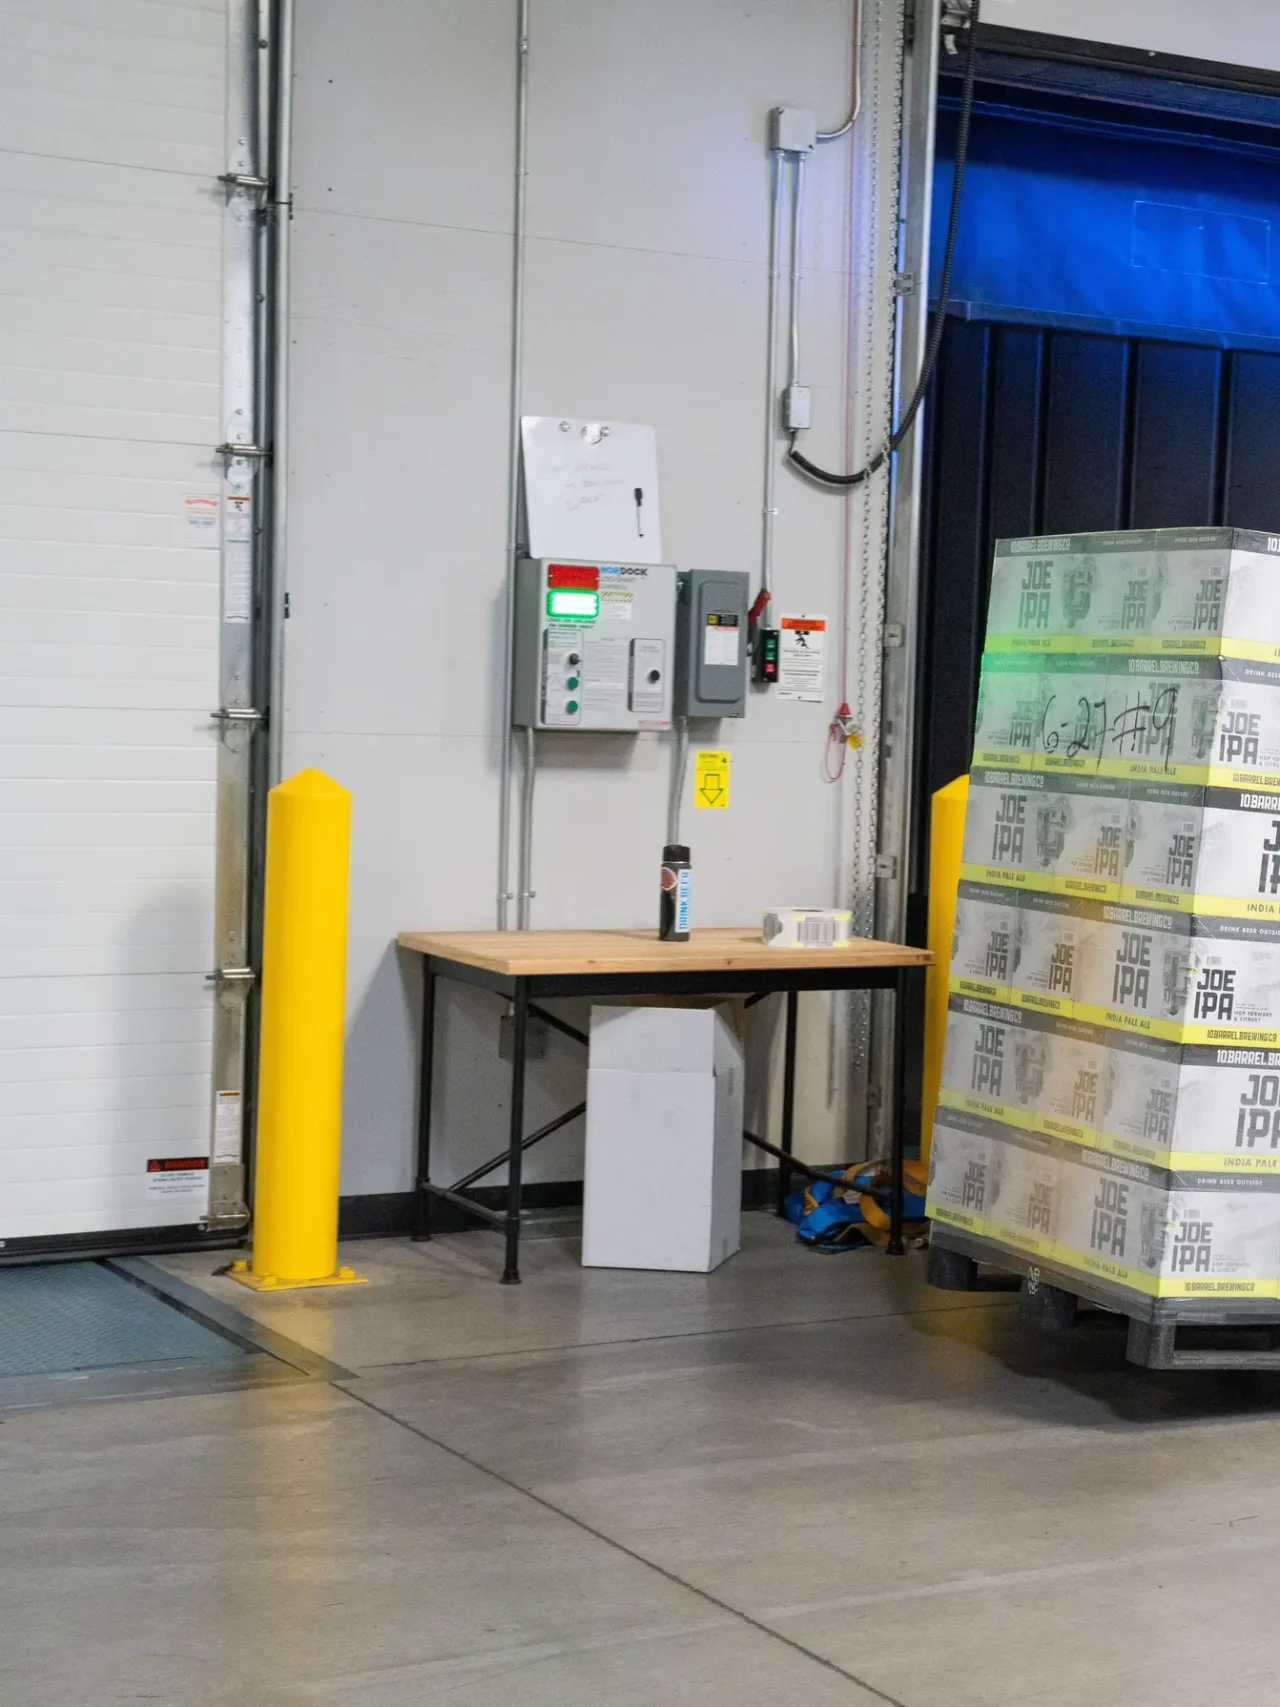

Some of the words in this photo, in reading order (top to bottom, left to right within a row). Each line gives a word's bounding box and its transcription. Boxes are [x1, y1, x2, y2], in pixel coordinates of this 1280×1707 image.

[1021, 560, 1054, 590] JOE
[1124, 580, 1149, 602] JOE
[1196, 579, 1223, 602] JOE
[1017, 592, 1051, 629] IPA
[1121, 603, 1147, 630] IPA
[1192, 603, 1220, 630] IPA
[1245, 668, 1265, 677] DRINK
[1221, 711, 1261, 736] JOE
[1219, 733, 1259, 765] IPA
[995, 794, 1028, 824] JOE
[992, 824, 1025, 863] IPA
[1097, 826, 1122, 848] JOE
[1169, 834, 1195, 858] JOE
[1094, 847, 1120, 876] IPA
[1165, 857, 1193, 887] IPA
[1247, 903, 1275, 914] INDIA
[988, 931, 1010, 953] JOE
[1220, 925, 1240, 933] DRINK
[1052, 943, 1075, 965] JOE
[1116, 931, 1153, 967] JOE
[984, 952, 1008, 980] IPA
[1048, 965, 1073, 993] IPA
[1112, 964, 1150, 1009] IPA
[1197, 968, 1236, 992] JOE
[1193, 991, 1234, 1021] IPA
[975, 1023, 1005, 1058] JOE
[971, 1053, 1003, 1097] IPA
[1074, 1069, 1099, 1094] JOE
[1071, 1090, 1096, 1122] IPA
[1146, 1088, 1173, 1115] JOE
[1142, 1111, 1168, 1144] IPA
[965, 1161, 987, 1185] JOE
[1224, 1157, 1252, 1167] INDIA
[1255, 1159, 1277, 1168] PALE
[961, 1182, 985, 1212] IPA
[1094, 1178, 1130, 1216] JOE
[1089, 1209, 1127, 1258] IPA
[1174, 1221, 1213, 1244] JOE
[1171, 1245, 1211, 1272] IPA
